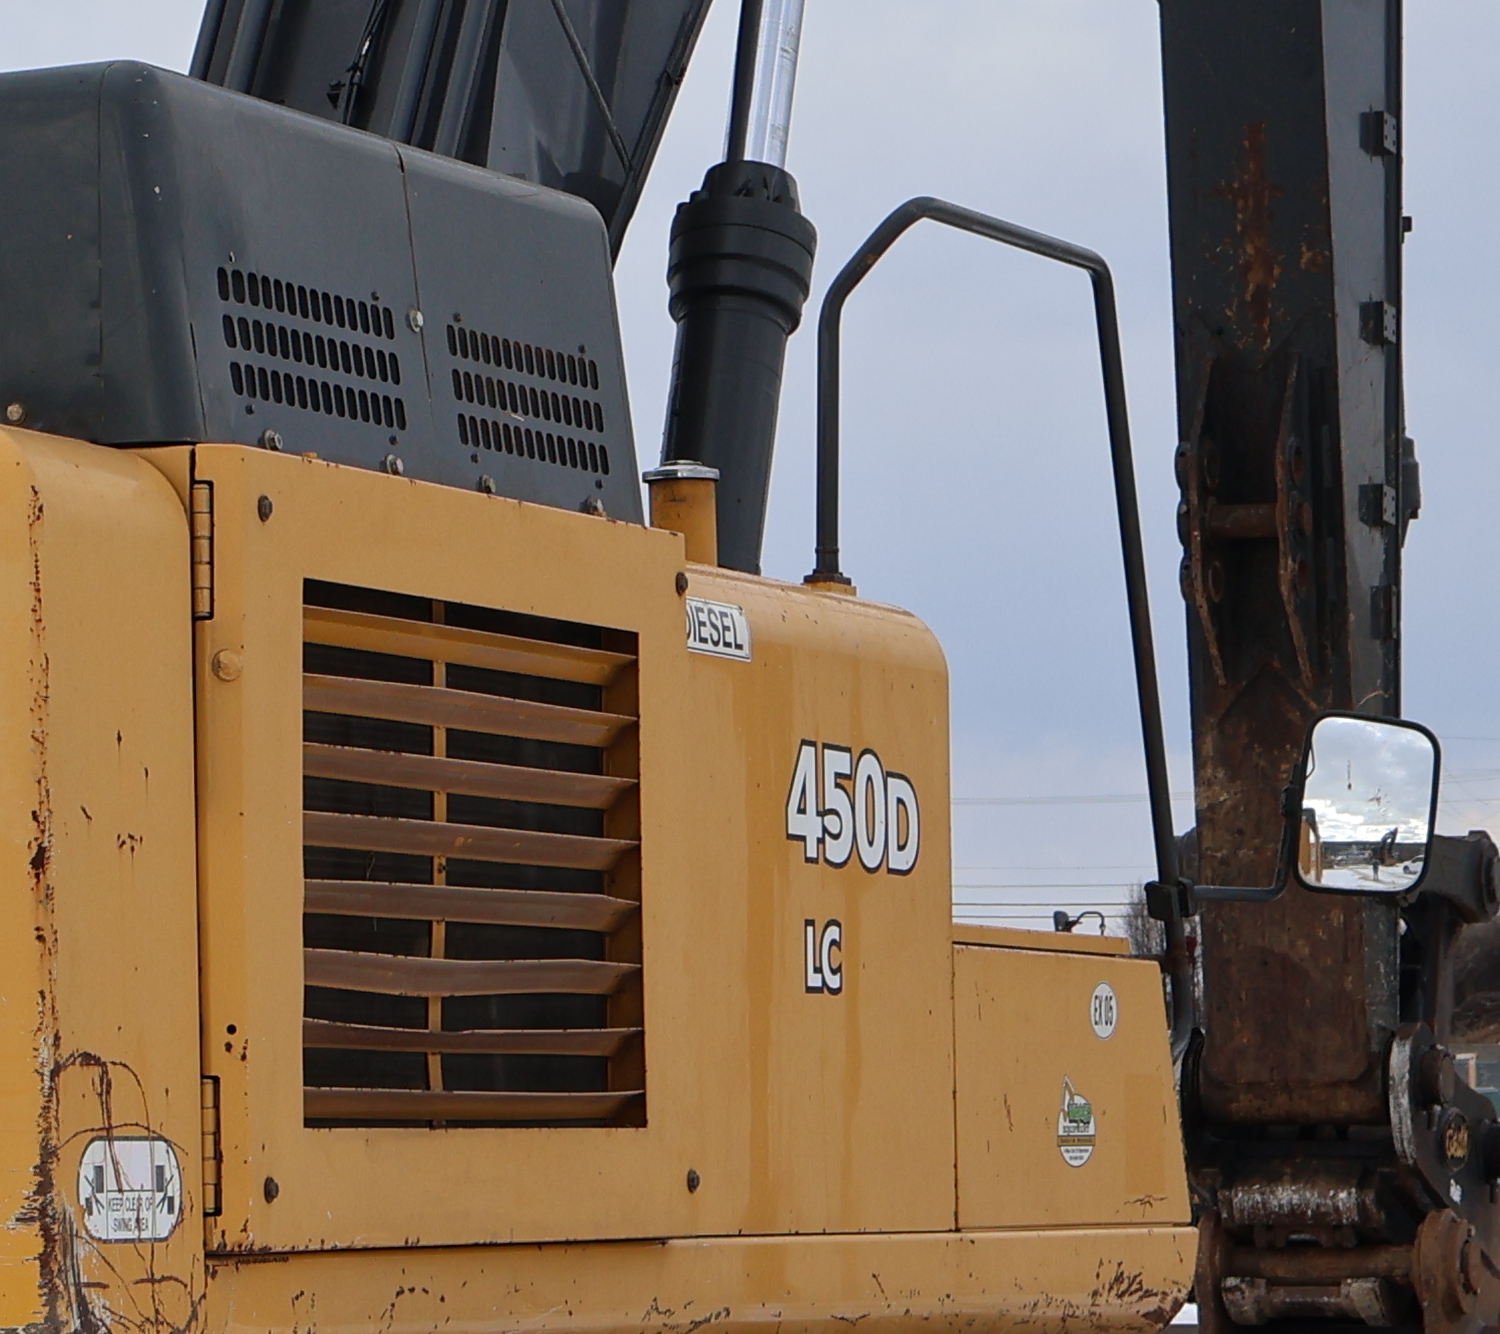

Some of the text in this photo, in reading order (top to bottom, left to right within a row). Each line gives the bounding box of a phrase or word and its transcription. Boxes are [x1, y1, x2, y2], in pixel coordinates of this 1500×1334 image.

[787, 740, 920, 876] 450D
[804, 919, 843, 995] LC
[133, 1217, 149, 1232] AEA
